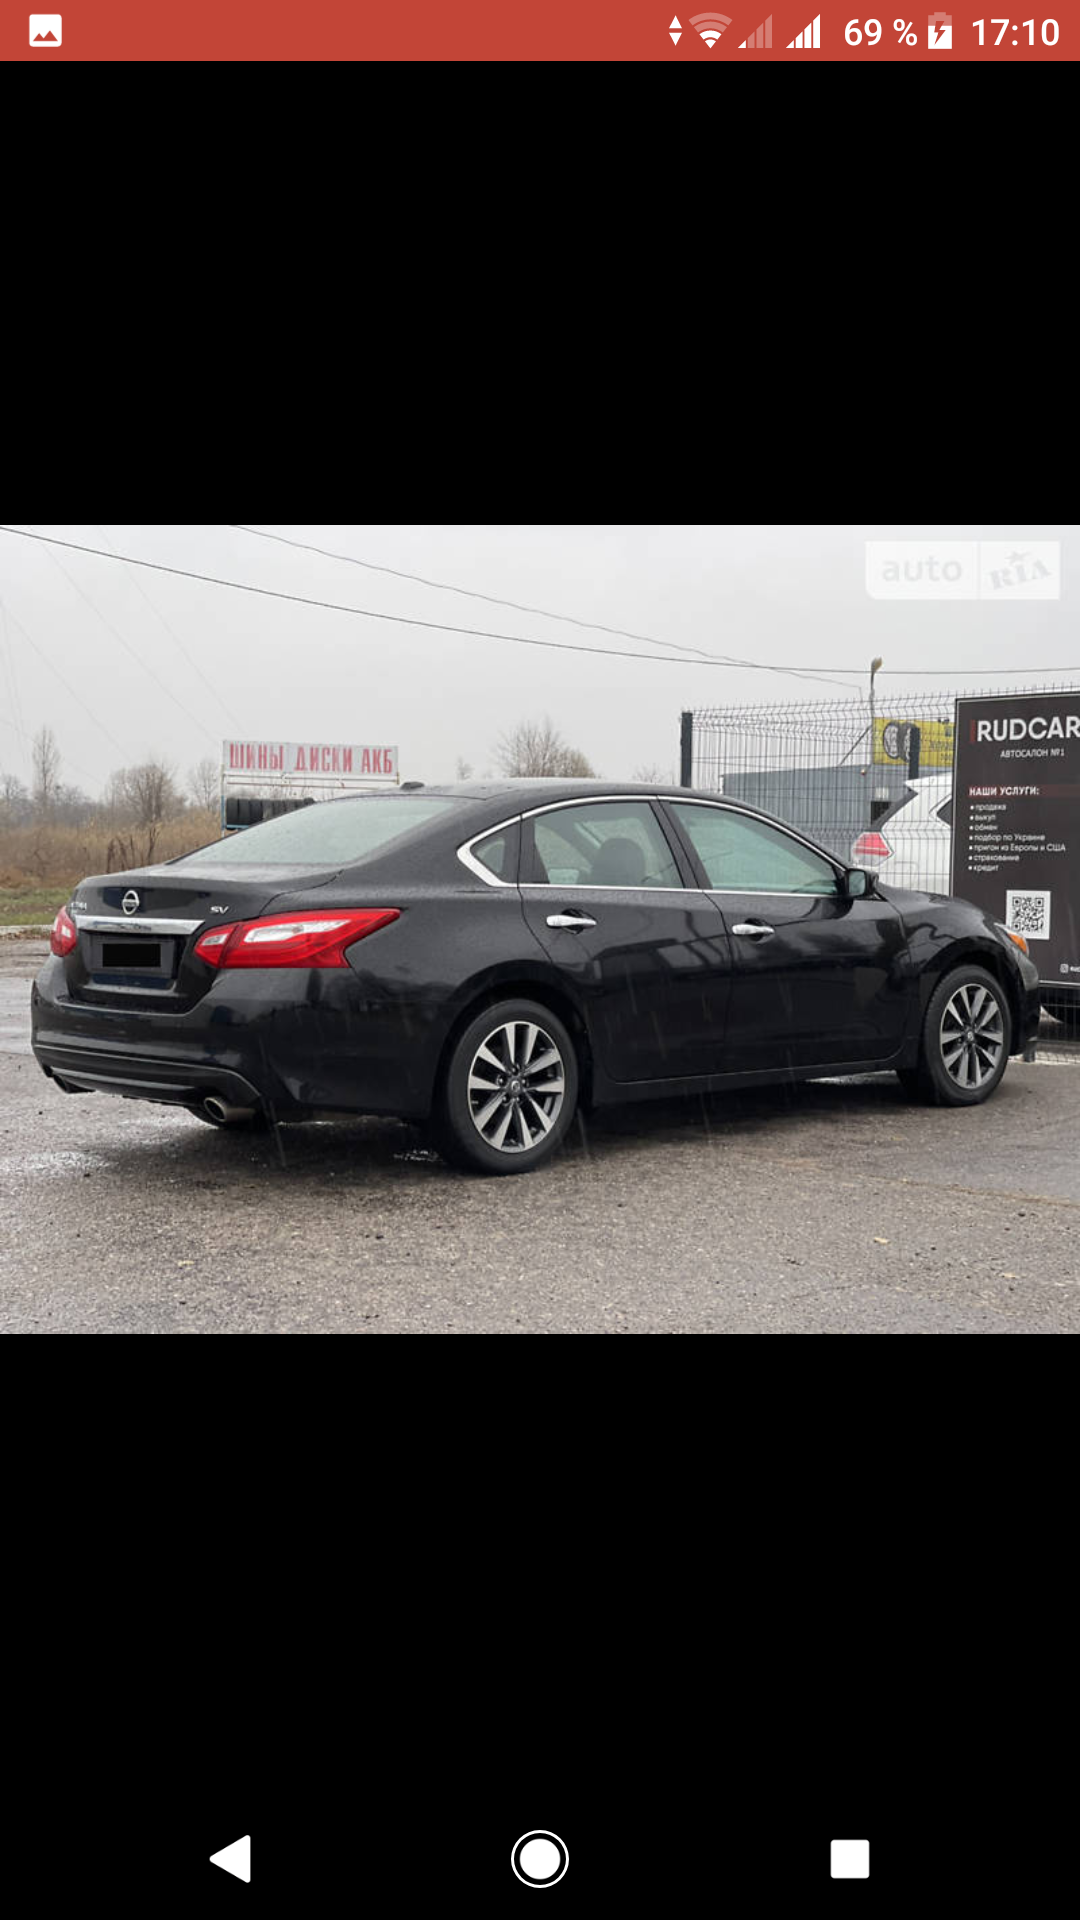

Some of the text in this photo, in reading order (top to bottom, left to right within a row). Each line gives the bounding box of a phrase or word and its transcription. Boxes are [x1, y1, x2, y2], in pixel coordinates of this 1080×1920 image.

[1000, 748, 1048, 758] АВТОСАЛОН
[229, 743, 393, 774] ШИНЫ ДИСКИ АКБ
[969, 786, 1040, 796] НАШИ УСЛУГИ:
[1046, 843, 1066, 852] США
[210, 905, 230, 915] SV
